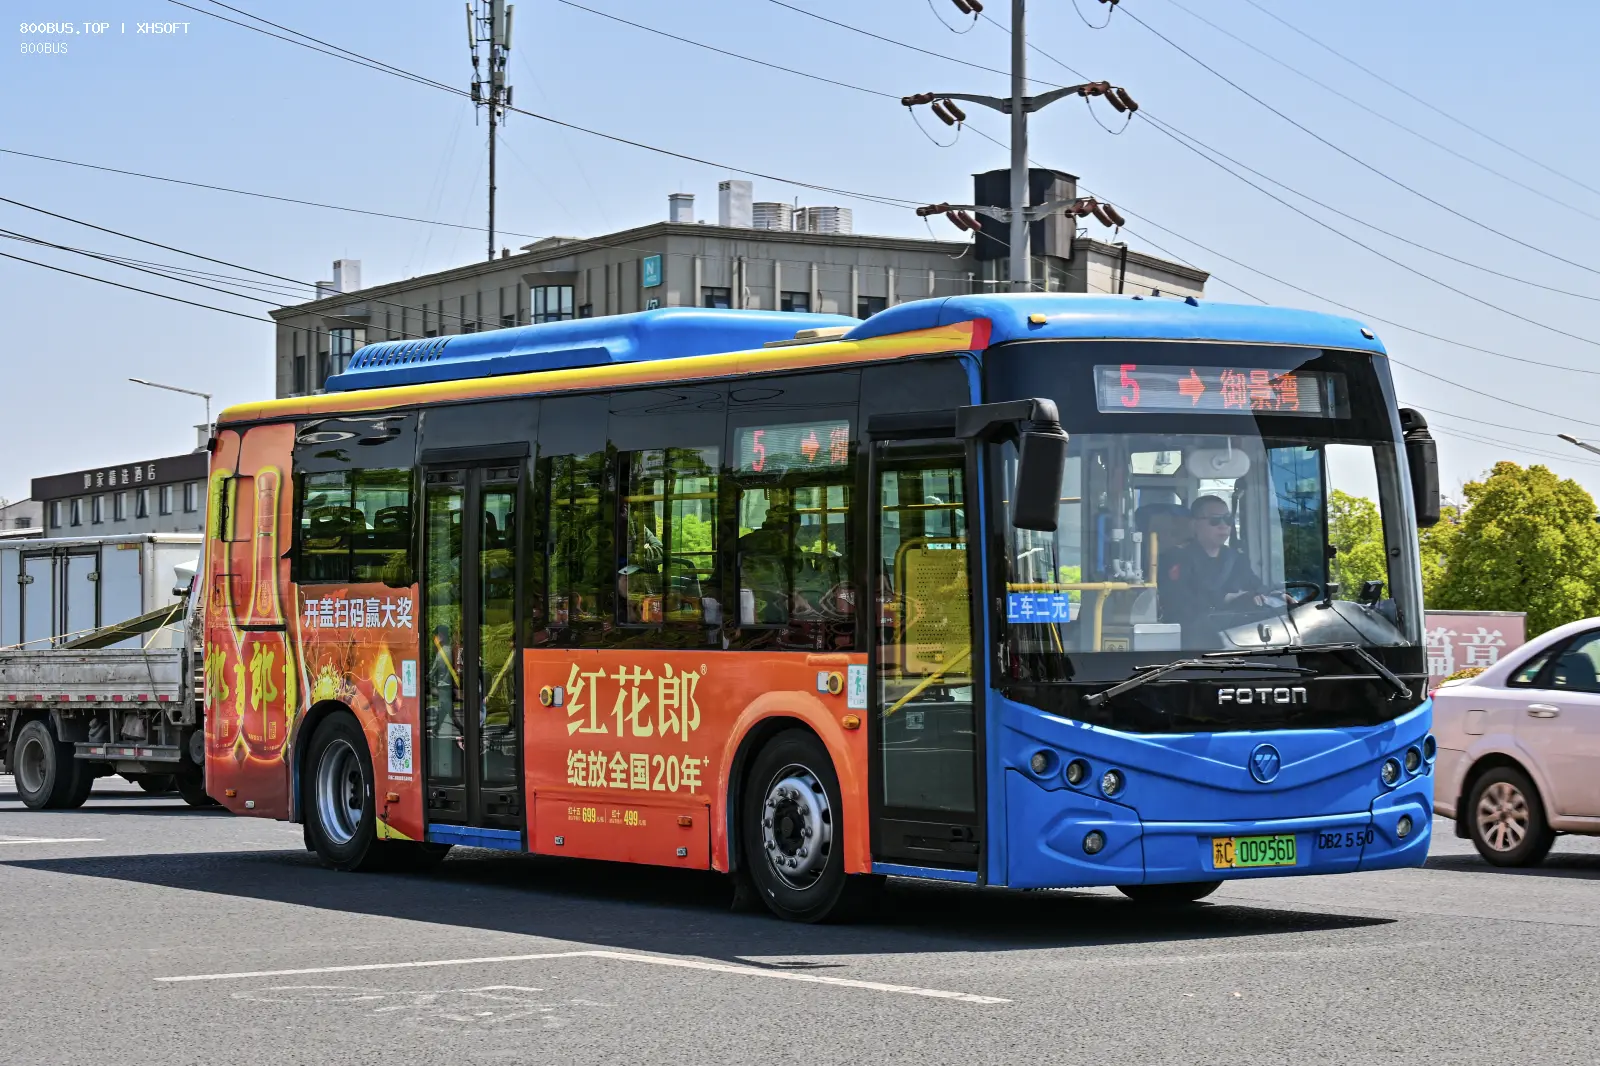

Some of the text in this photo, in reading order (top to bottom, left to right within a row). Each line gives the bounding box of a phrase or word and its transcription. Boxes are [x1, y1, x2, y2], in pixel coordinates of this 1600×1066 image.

[1120, 363, 1140, 408] 5
[1219, 368, 1300, 411] 御景湾
[751, 429, 765, 472] 5
[304, 597, 413, 628] 开盖扫码赢大奖
[1006, 595, 1067, 619] 上车二元
[566, 662, 701, 742] 红花郎
[1218, 687, 1307, 705] FOTON
[582, 807, 596, 823] 699
[624, 810, 638, 826] 499
